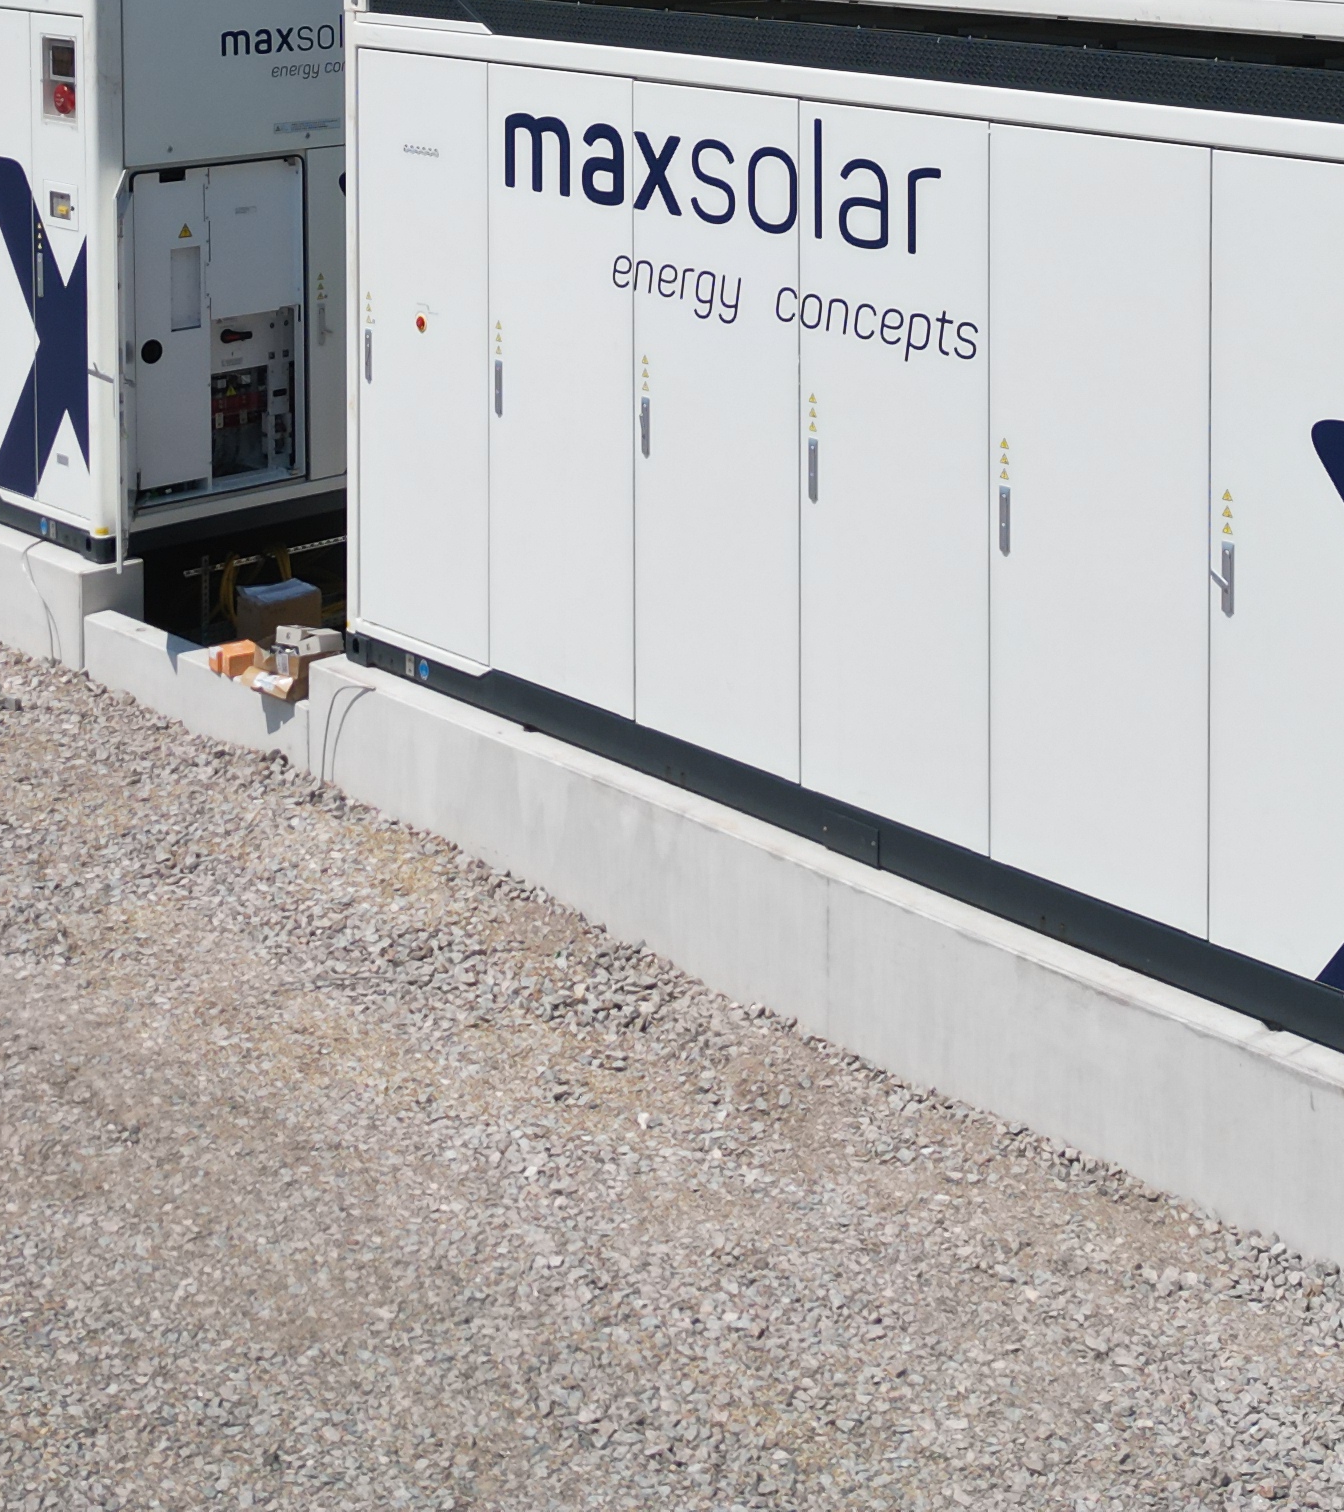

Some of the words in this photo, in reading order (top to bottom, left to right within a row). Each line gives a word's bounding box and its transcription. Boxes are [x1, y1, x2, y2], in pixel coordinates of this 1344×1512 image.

[272, 64, 320, 79] energy
[505, 112, 942, 254] maxsolar
[612, 255, 742, 325] energy
[775, 286, 979, 362] concepts
